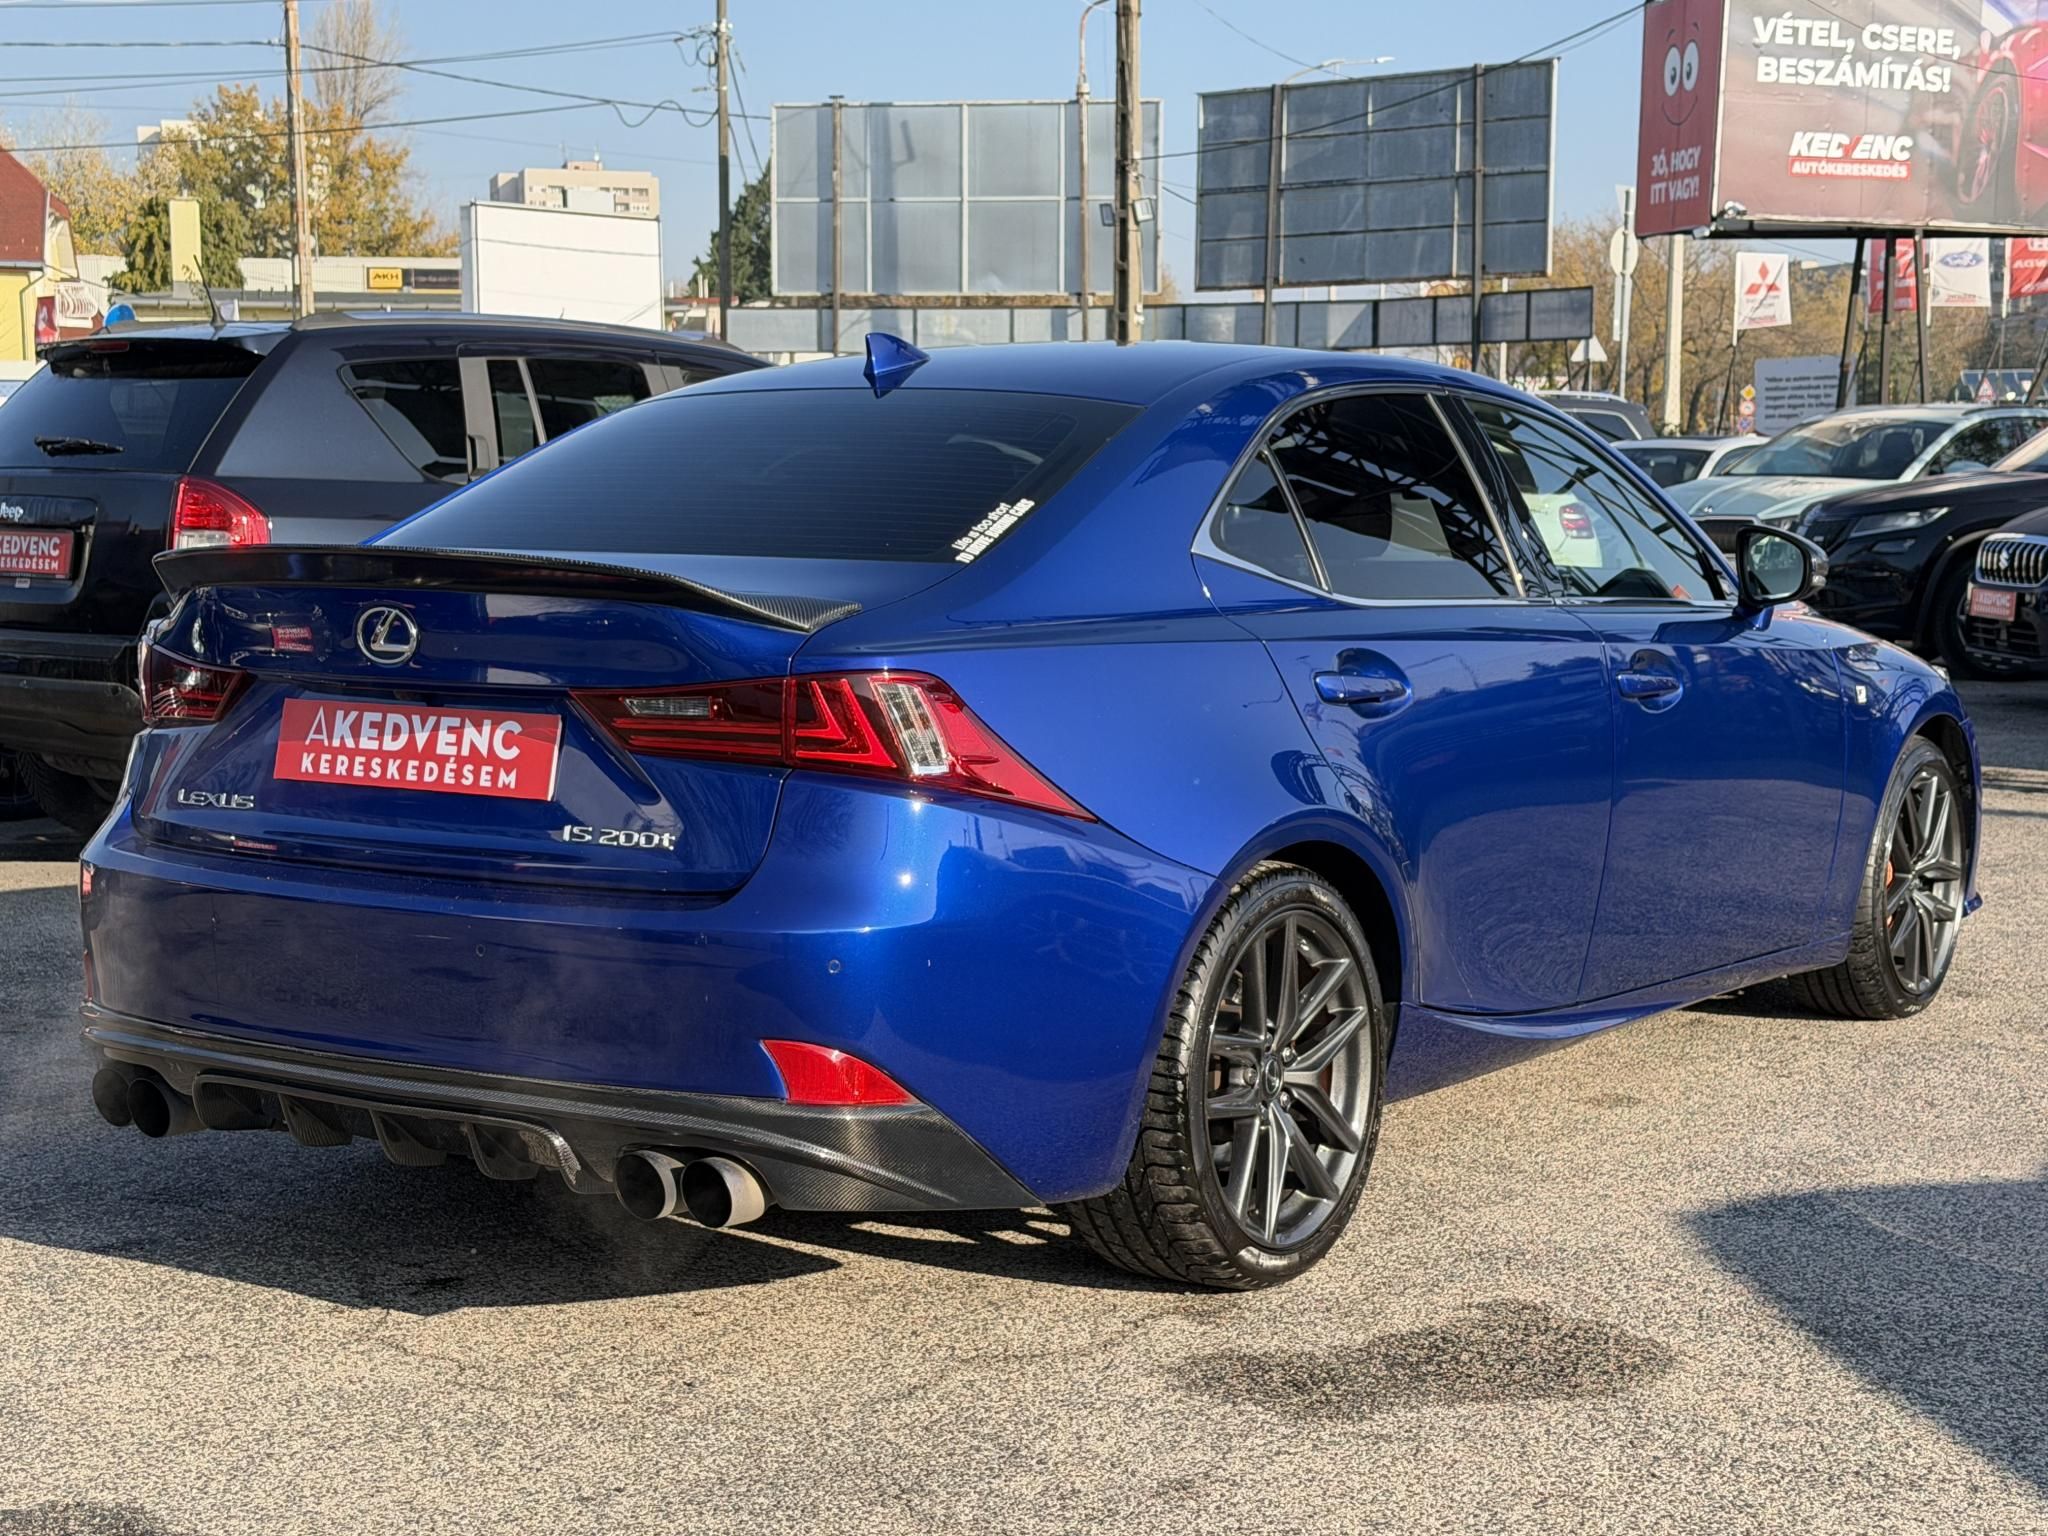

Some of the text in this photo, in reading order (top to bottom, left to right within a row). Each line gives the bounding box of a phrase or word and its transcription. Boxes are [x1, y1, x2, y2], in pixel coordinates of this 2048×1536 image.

[1752, 11, 1961, 60] VÉTEL, CSERE,
[1756, 55, 1951, 93] BESZÁMÍTÁS!
[1651, 144, 1702, 179] JÓ, HOGY
[1791, 160, 1909, 179] AUTÓKERESKEDÉS
[1650, 175, 1700, 205] ITT VAGY!
[971, 519, 993, 533] too
[300, 752, 517, 790] KERESKEDÉSEM
[177, 788, 255, 809] LEXUS
[562, 824, 676, 851] IS 200t
